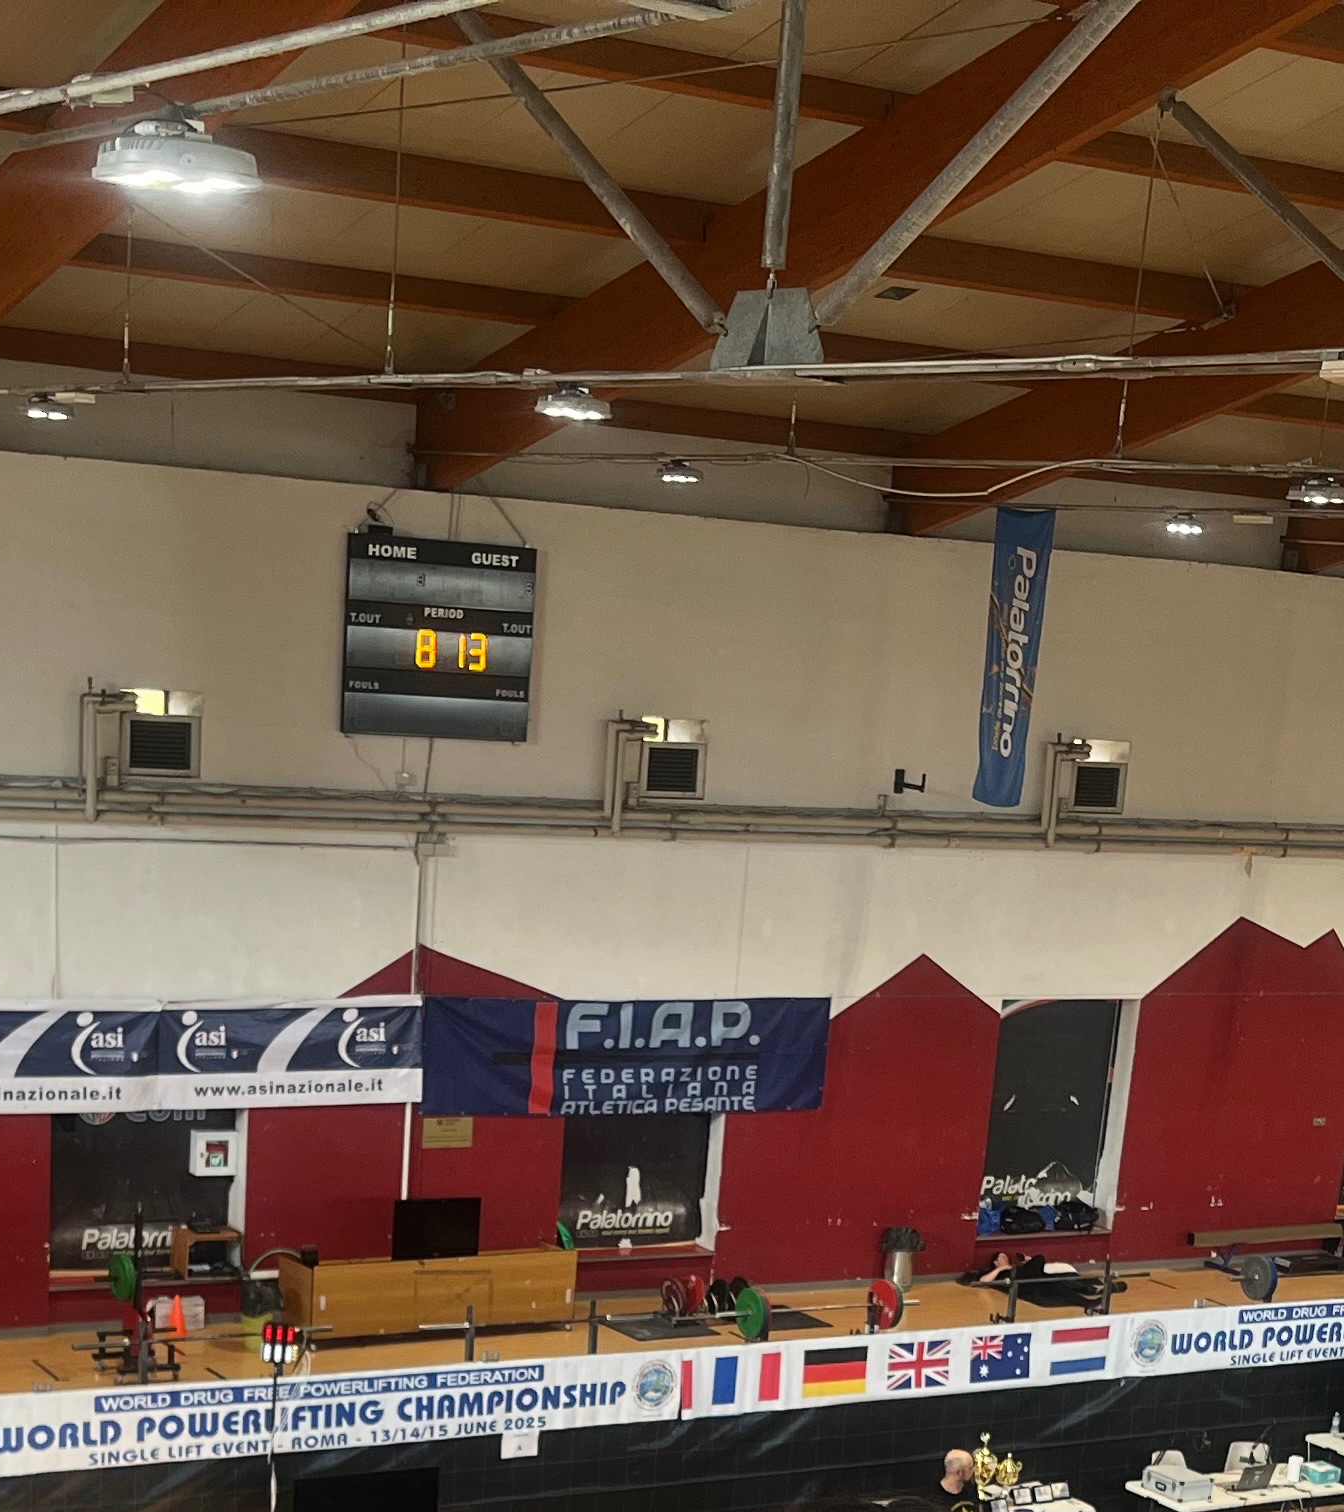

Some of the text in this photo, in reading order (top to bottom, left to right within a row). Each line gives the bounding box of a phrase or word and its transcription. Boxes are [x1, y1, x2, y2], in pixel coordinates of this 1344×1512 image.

[368, 544, 417, 559] HOME
[471, 552, 519, 567] GUEST
[350, 612, 381, 624] T.OUT
[424, 607, 464, 619] PERIOD
[502, 623, 532, 634] T.OUT
[415, 629, 488, 672] 8 13
[998, 546, 1037, 759] Palatorrino
[349, 681, 379, 690] FOULS
[495, 689, 524, 699] FOULS
[194, 1025, 227, 1046] asi
[355, 1022, 386, 1042] asi
[565, 1001, 760, 1050] F.I.A.P.
[90, 1027, 124, 1048] asi
[562, 1065, 757, 1084] FEDERAZIONE
[194, 1077, 383, 1097] www.asinazionale.it
[563, 1081, 755, 1100] ITALIANA
[560, 1096, 756, 1115] ATLETICA PESANTE
[576, 1208, 673, 1231] Palatorrino
[1242, 1309, 1287, 1322] WORLD
[1292, 1305, 1327, 1319] DRUG
[1171, 1329, 1253, 1355] WORLD
[1230, 1352, 1274, 1366] SINGLE
[1280, 1349, 1303, 1362] LIFT
[1307, 1346, 1344, 1359] EVENT
[100, 1366, 540, 1412] WORLD DRUG FREE POWERLIFTING FEDERATION
[137, 1399, 384, 1442] POWERLIFTING
[397, 1380, 626, 1423] CHAMPIONSHIP
[89, 1447, 160, 1466] SINGLE
[168, 1444, 203, 1459] LIFT
[211, 1439, 269, 1455] EVENT
[291, 1433, 348, 1450] ROMA
[371, 1422, 448, 1444] 13/14/15
[455, 1419, 499, 1436] JUNE
[504, 1416, 546, 1431] 2025
